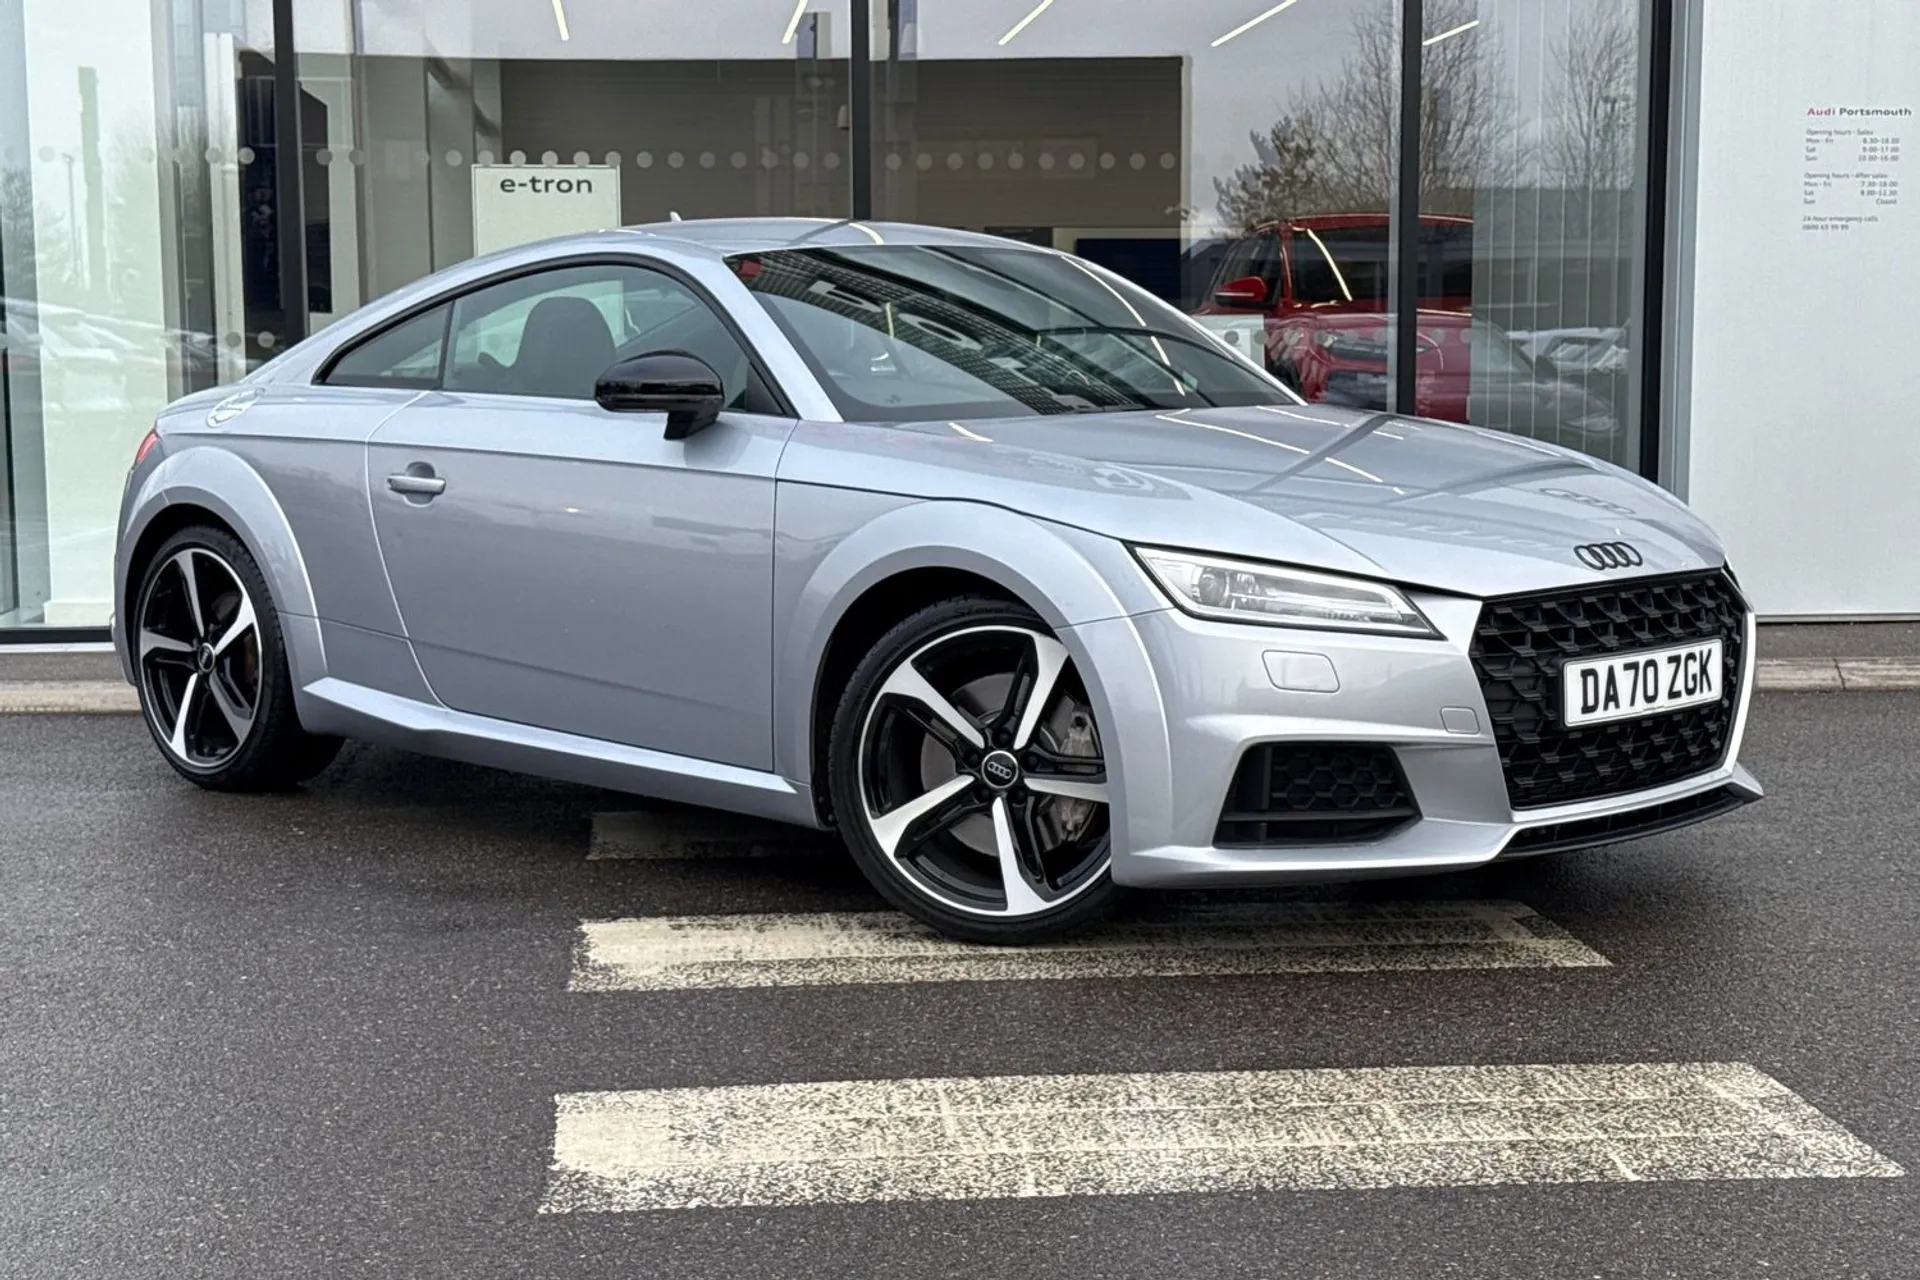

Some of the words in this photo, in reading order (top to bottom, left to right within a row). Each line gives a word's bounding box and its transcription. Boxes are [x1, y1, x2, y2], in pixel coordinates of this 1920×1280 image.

[1807, 107, 1836, 116] Audi
[1839, 107, 1912, 116] Portsmouth
[500, 176, 592, 194] e-tron
[1580, 659, 1659, 714] DA70
[1667, 648, 1712, 701] ZGK
